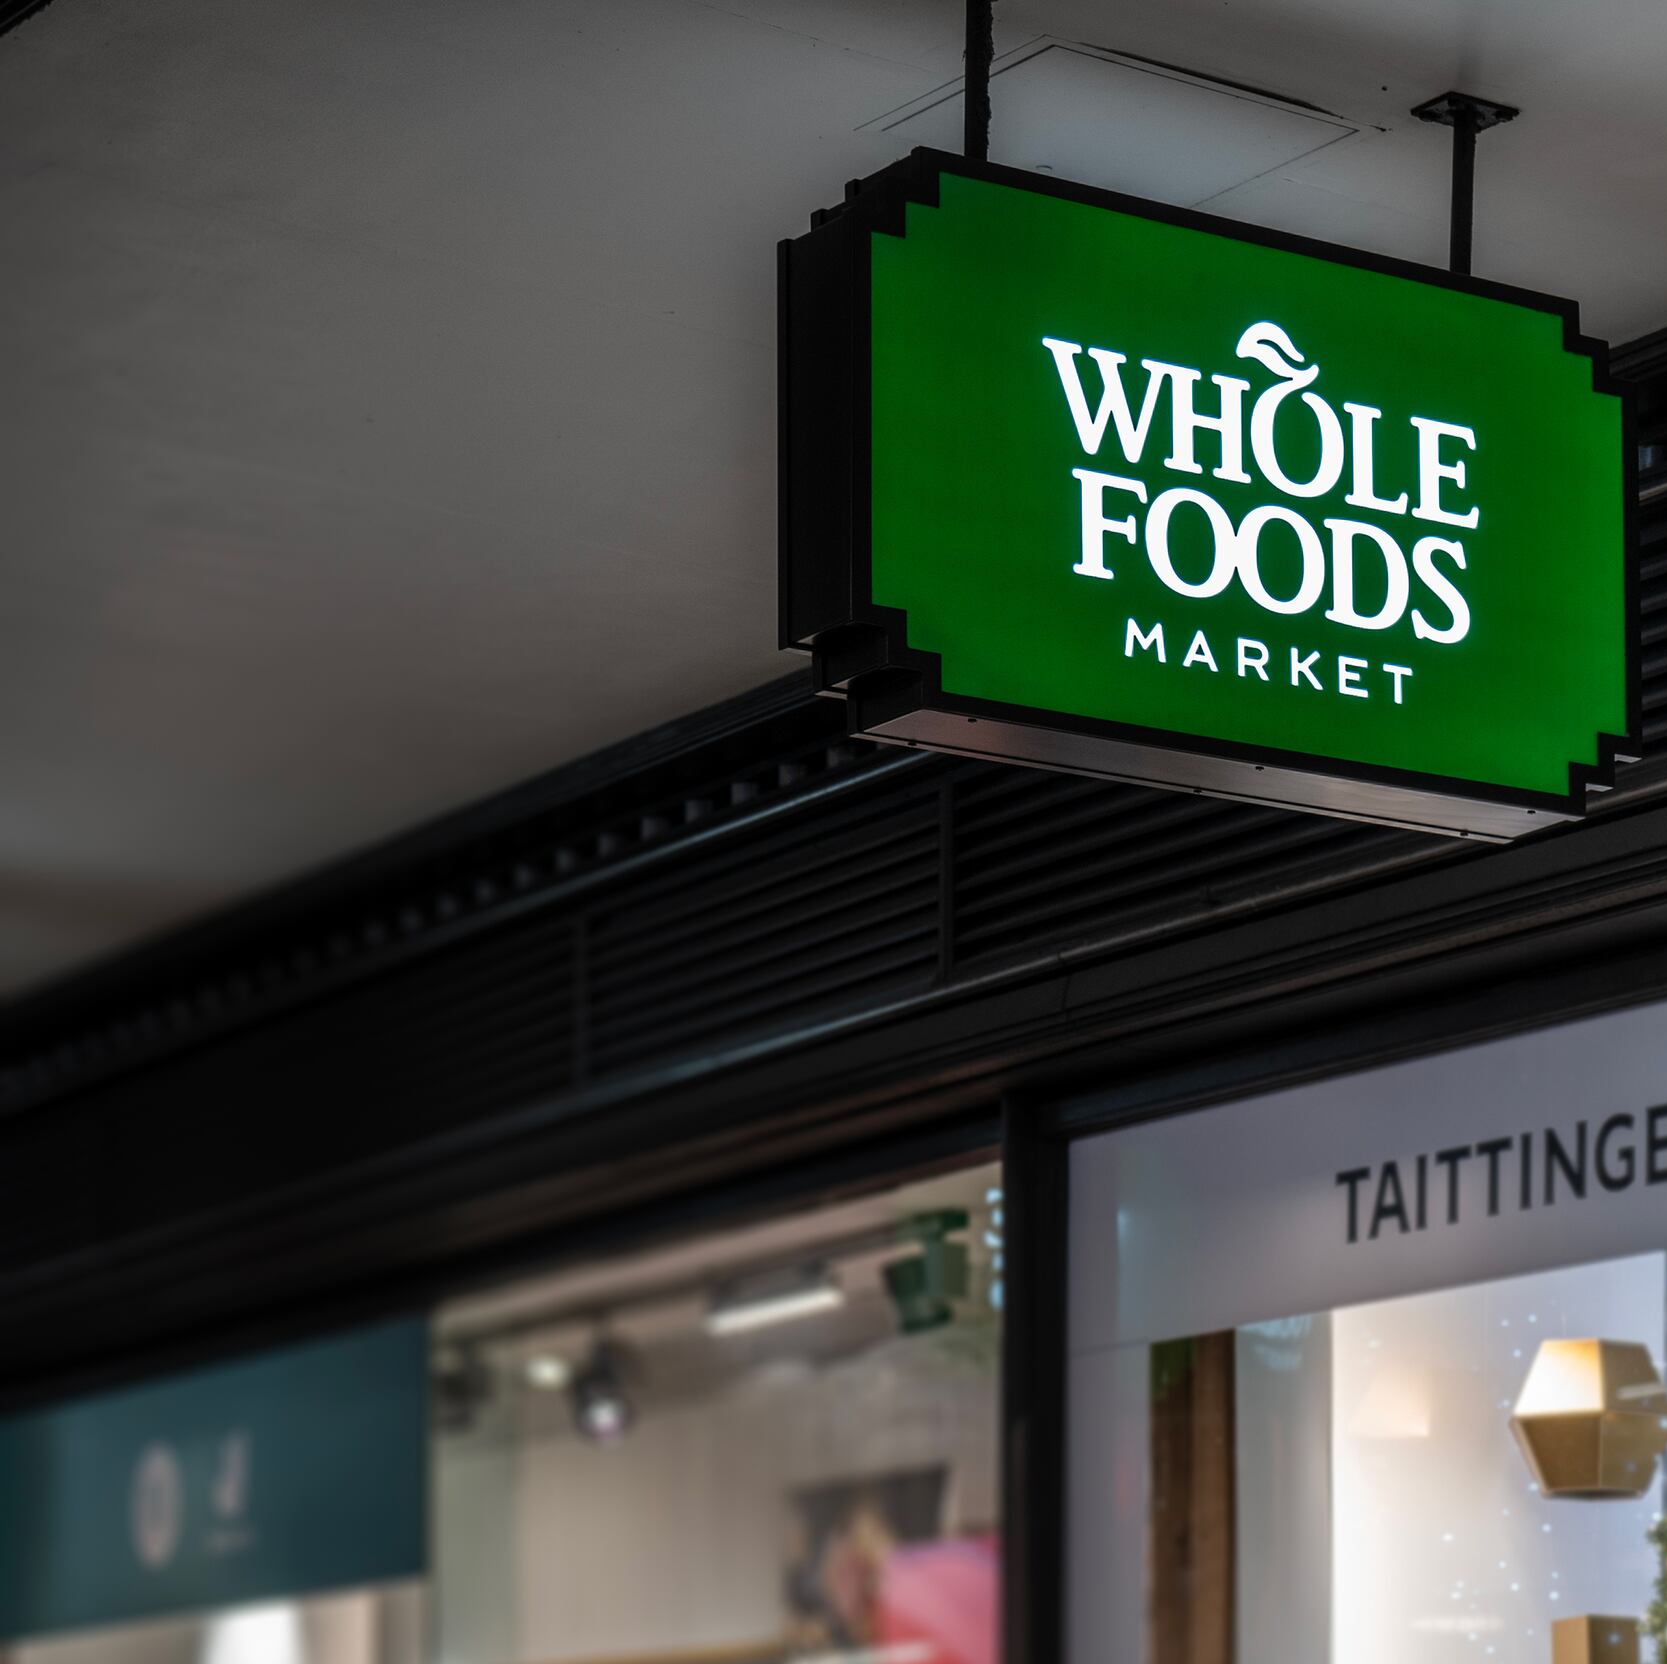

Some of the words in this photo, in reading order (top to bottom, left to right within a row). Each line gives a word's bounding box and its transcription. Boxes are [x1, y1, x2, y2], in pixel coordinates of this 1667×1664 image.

[1043, 325, 1479, 528] WHOLE
[1072, 468, 1471, 644] FOODS
[1124, 618, 1413, 705] MARKET
